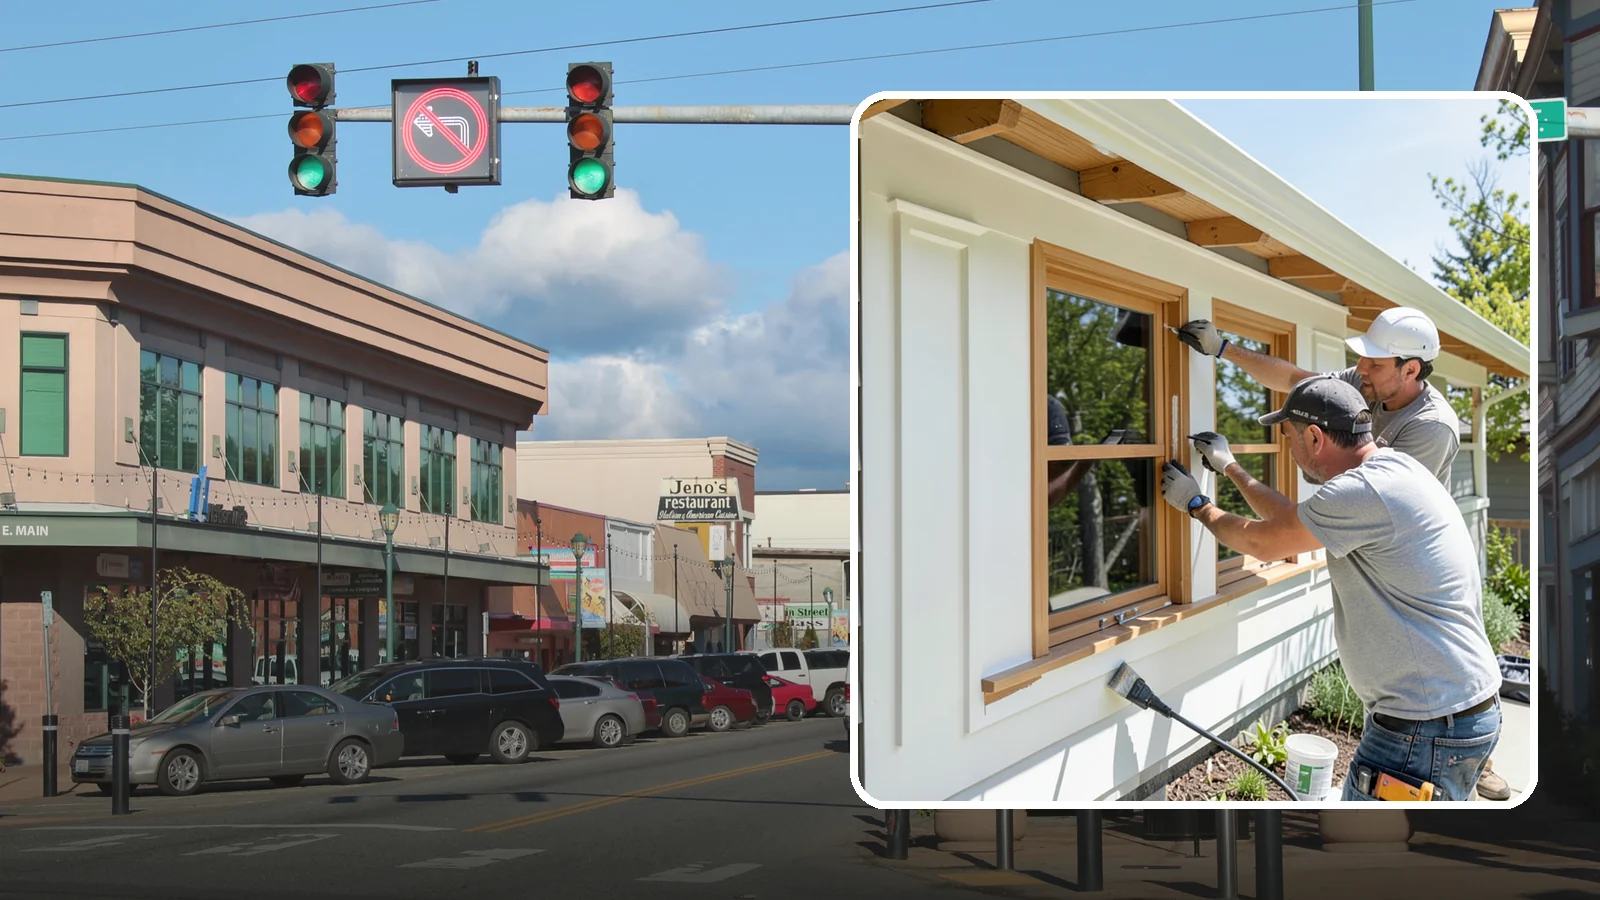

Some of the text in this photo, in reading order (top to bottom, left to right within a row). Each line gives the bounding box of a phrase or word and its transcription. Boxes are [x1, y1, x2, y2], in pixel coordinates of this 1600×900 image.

[670, 480, 728, 495] Jeno's
[665, 497, 731, 509] restaurant
[658, 510, 681, 519] Italian
[686, 509, 714, 519] American
[714, 509, 738, 519] Cuisine
[2, 525, 49, 536] E. MAIN
[797, 607, 829, 617] Street
